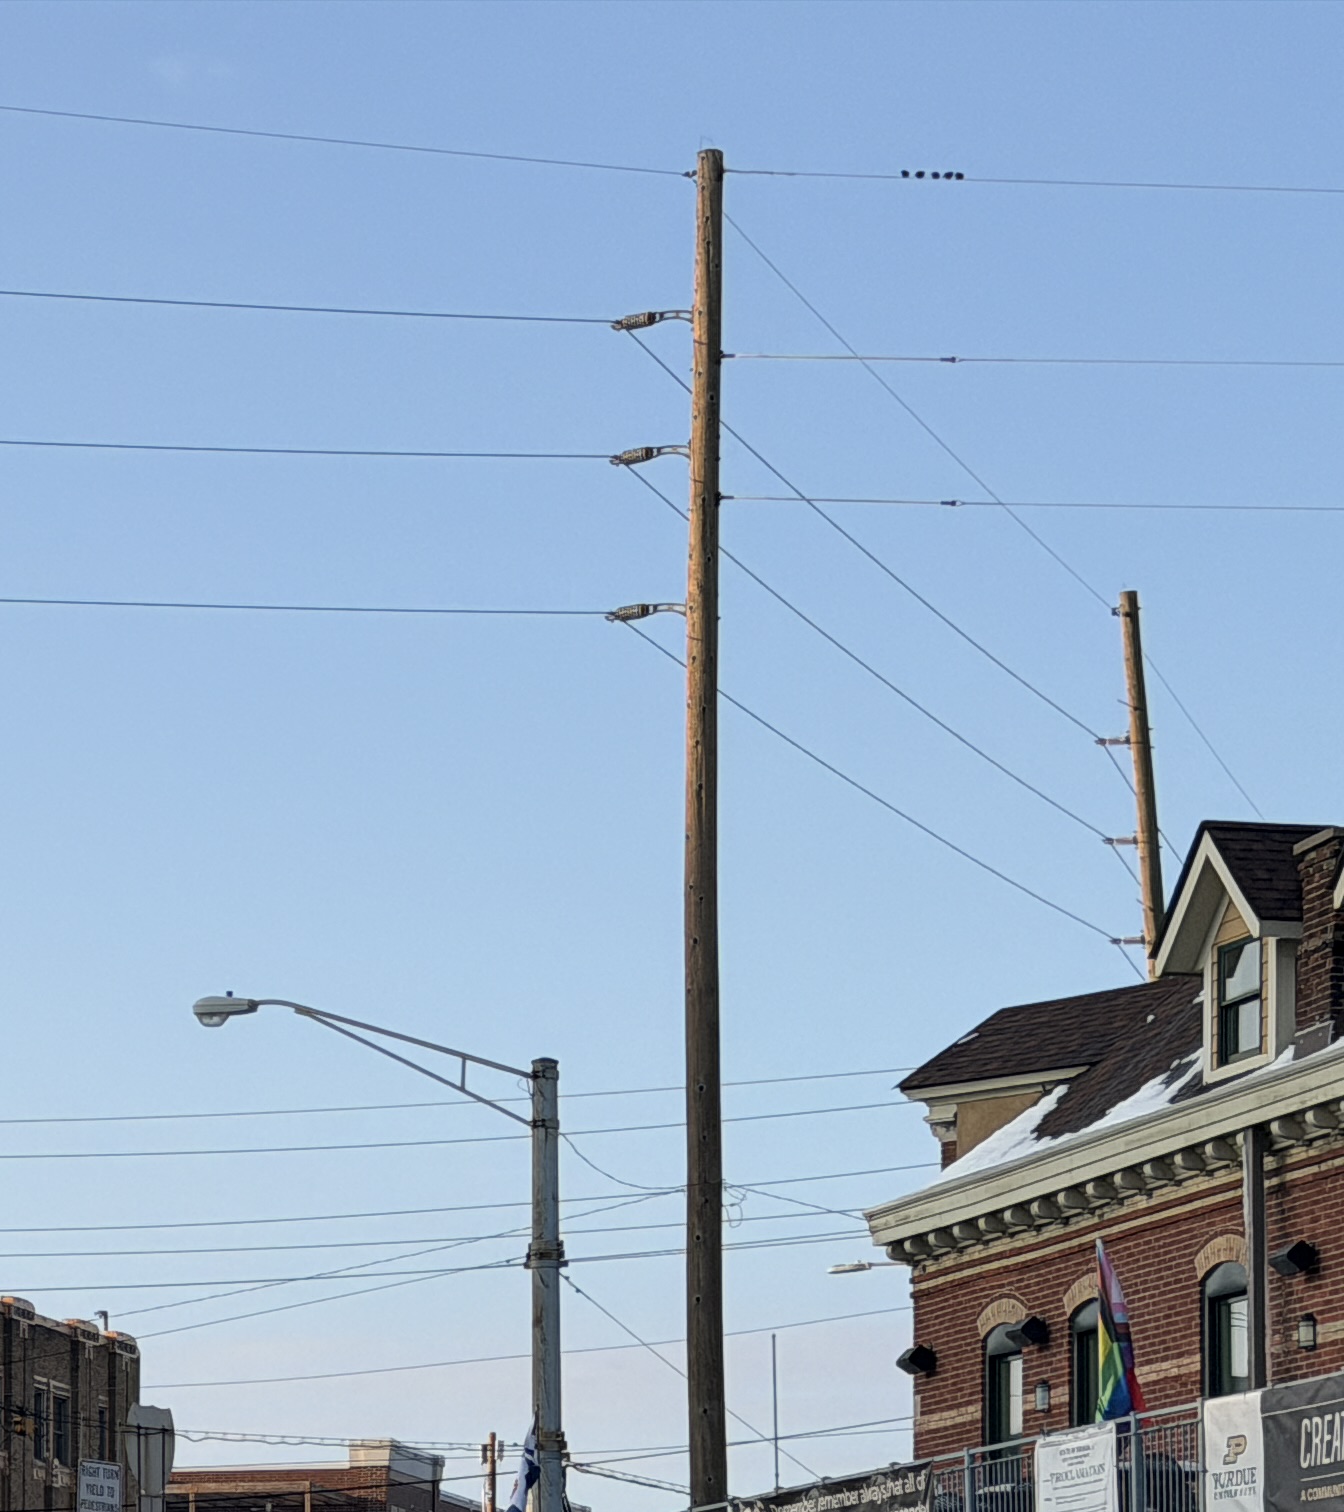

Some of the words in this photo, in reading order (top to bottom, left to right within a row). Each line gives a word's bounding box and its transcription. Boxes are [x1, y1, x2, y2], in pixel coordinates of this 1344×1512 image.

[81, 1465, 100, 1478] RIGHT
[103, 1467, 119, 1480] TURN
[904, 1472, 915, 1493] all
[916, 1470, 927, 1491] of
[1212, 1467, 1256, 1490] PURDUE
[86, 1483, 104, 1496] YIELD
[107, 1486, 115, 1498] TO
